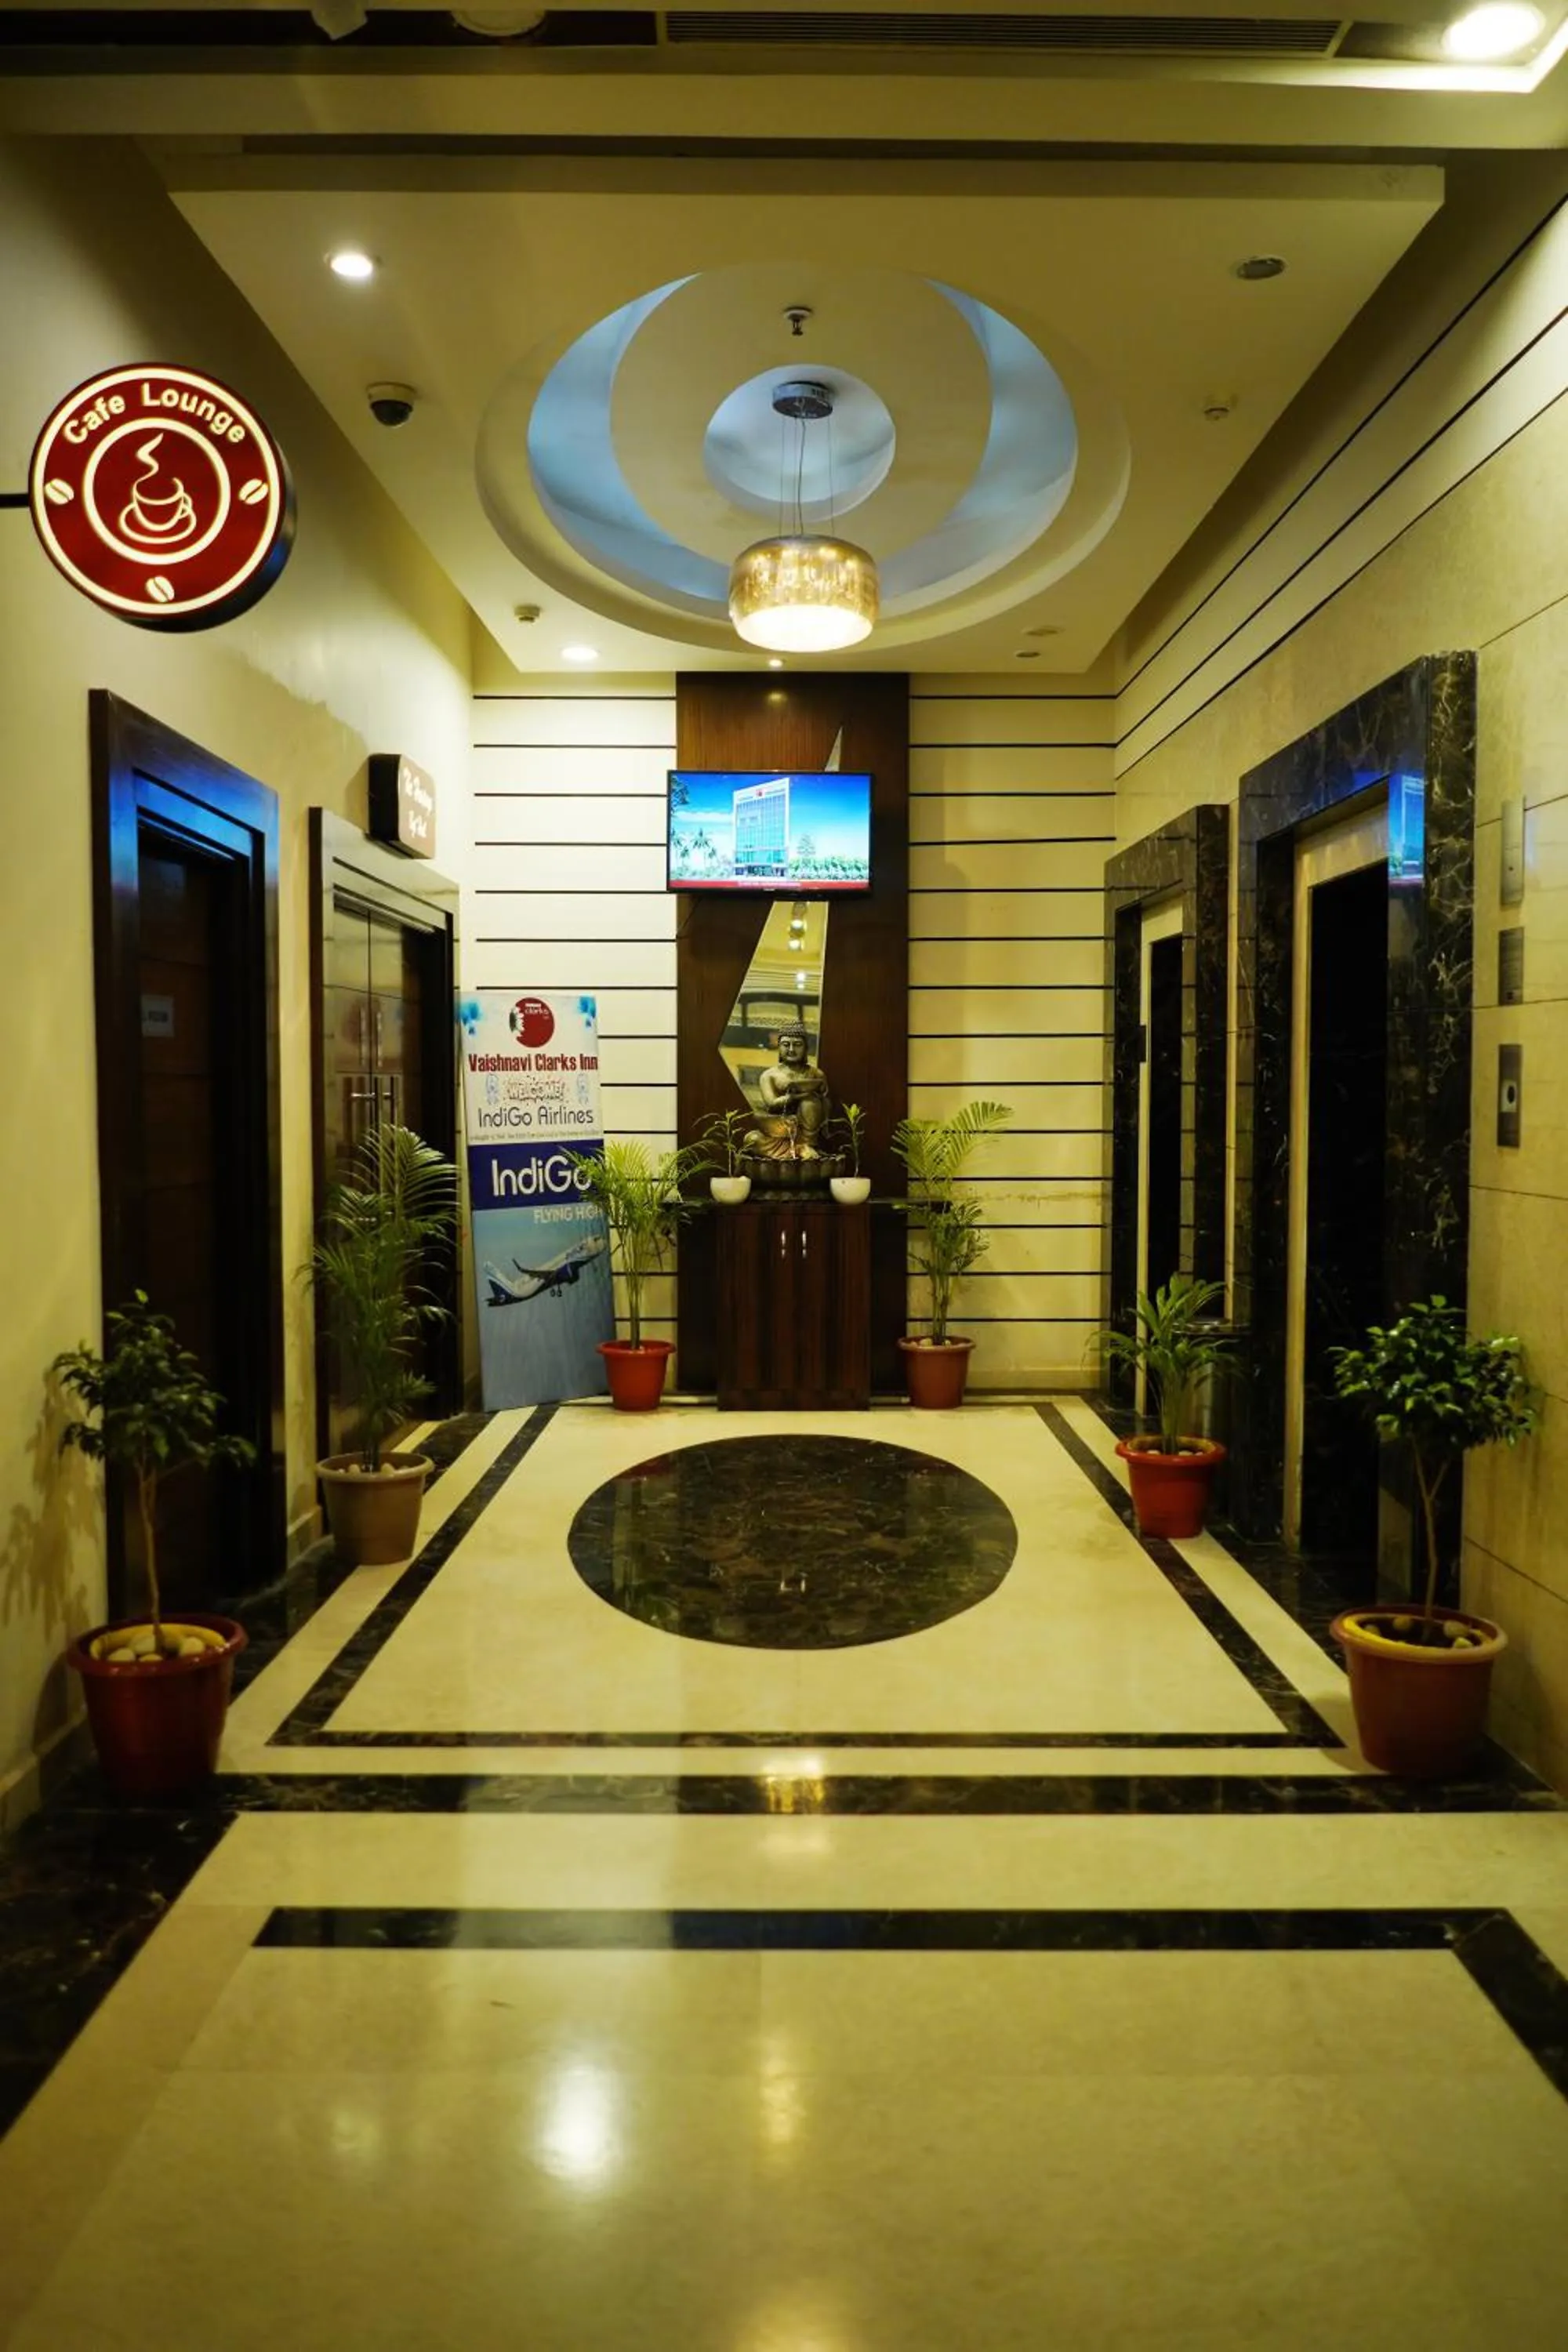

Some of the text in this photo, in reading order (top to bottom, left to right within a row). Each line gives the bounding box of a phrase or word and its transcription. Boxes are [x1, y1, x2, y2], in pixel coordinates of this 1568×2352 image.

[63, 382, 246, 445] Cafe Lounge
[468, 1053, 598, 1073] Vaishnavi Clarks Inn
[478, 1105, 594, 1127] IndiGo Airlines
[492, 1155, 592, 1197] IndiGo
